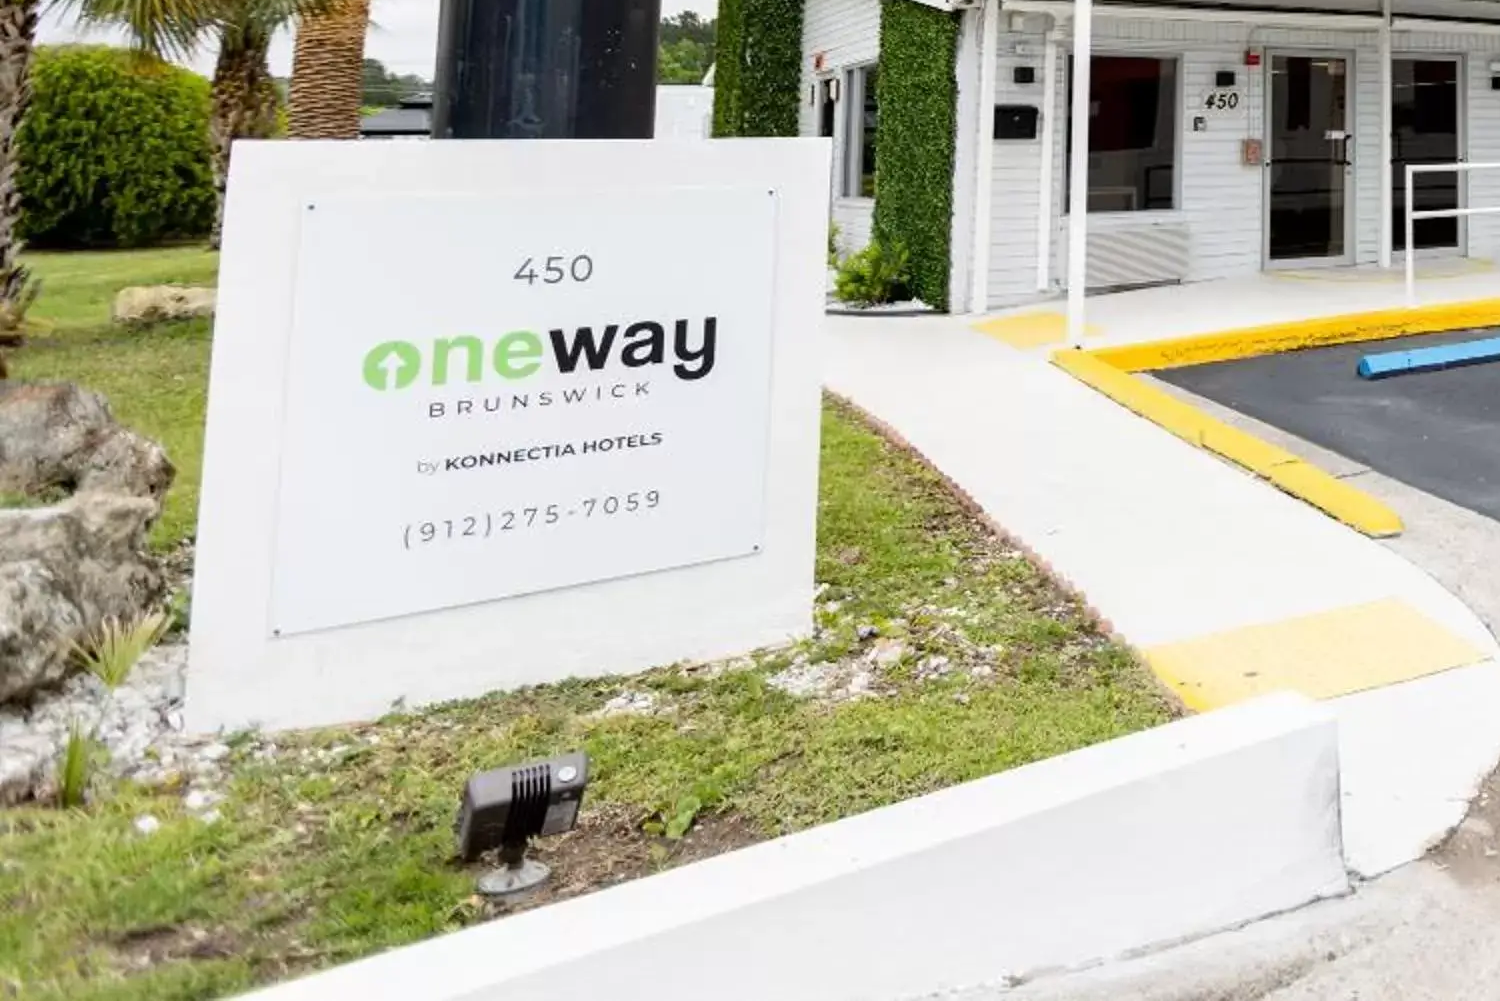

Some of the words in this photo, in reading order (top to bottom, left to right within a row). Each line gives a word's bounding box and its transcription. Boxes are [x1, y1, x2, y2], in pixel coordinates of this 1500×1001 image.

[1204, 92, 1239, 109] 450
[512, 253, 595, 286] 450
[361, 315, 718, 392] oneway
[427, 380, 652, 419] BRUNSWICK
[416, 459, 440, 476] by
[444, 443, 577, 472] KONNECTIA
[581, 431, 664, 454] HOTELS
[402, 489, 661, 550] (912)275-7059
